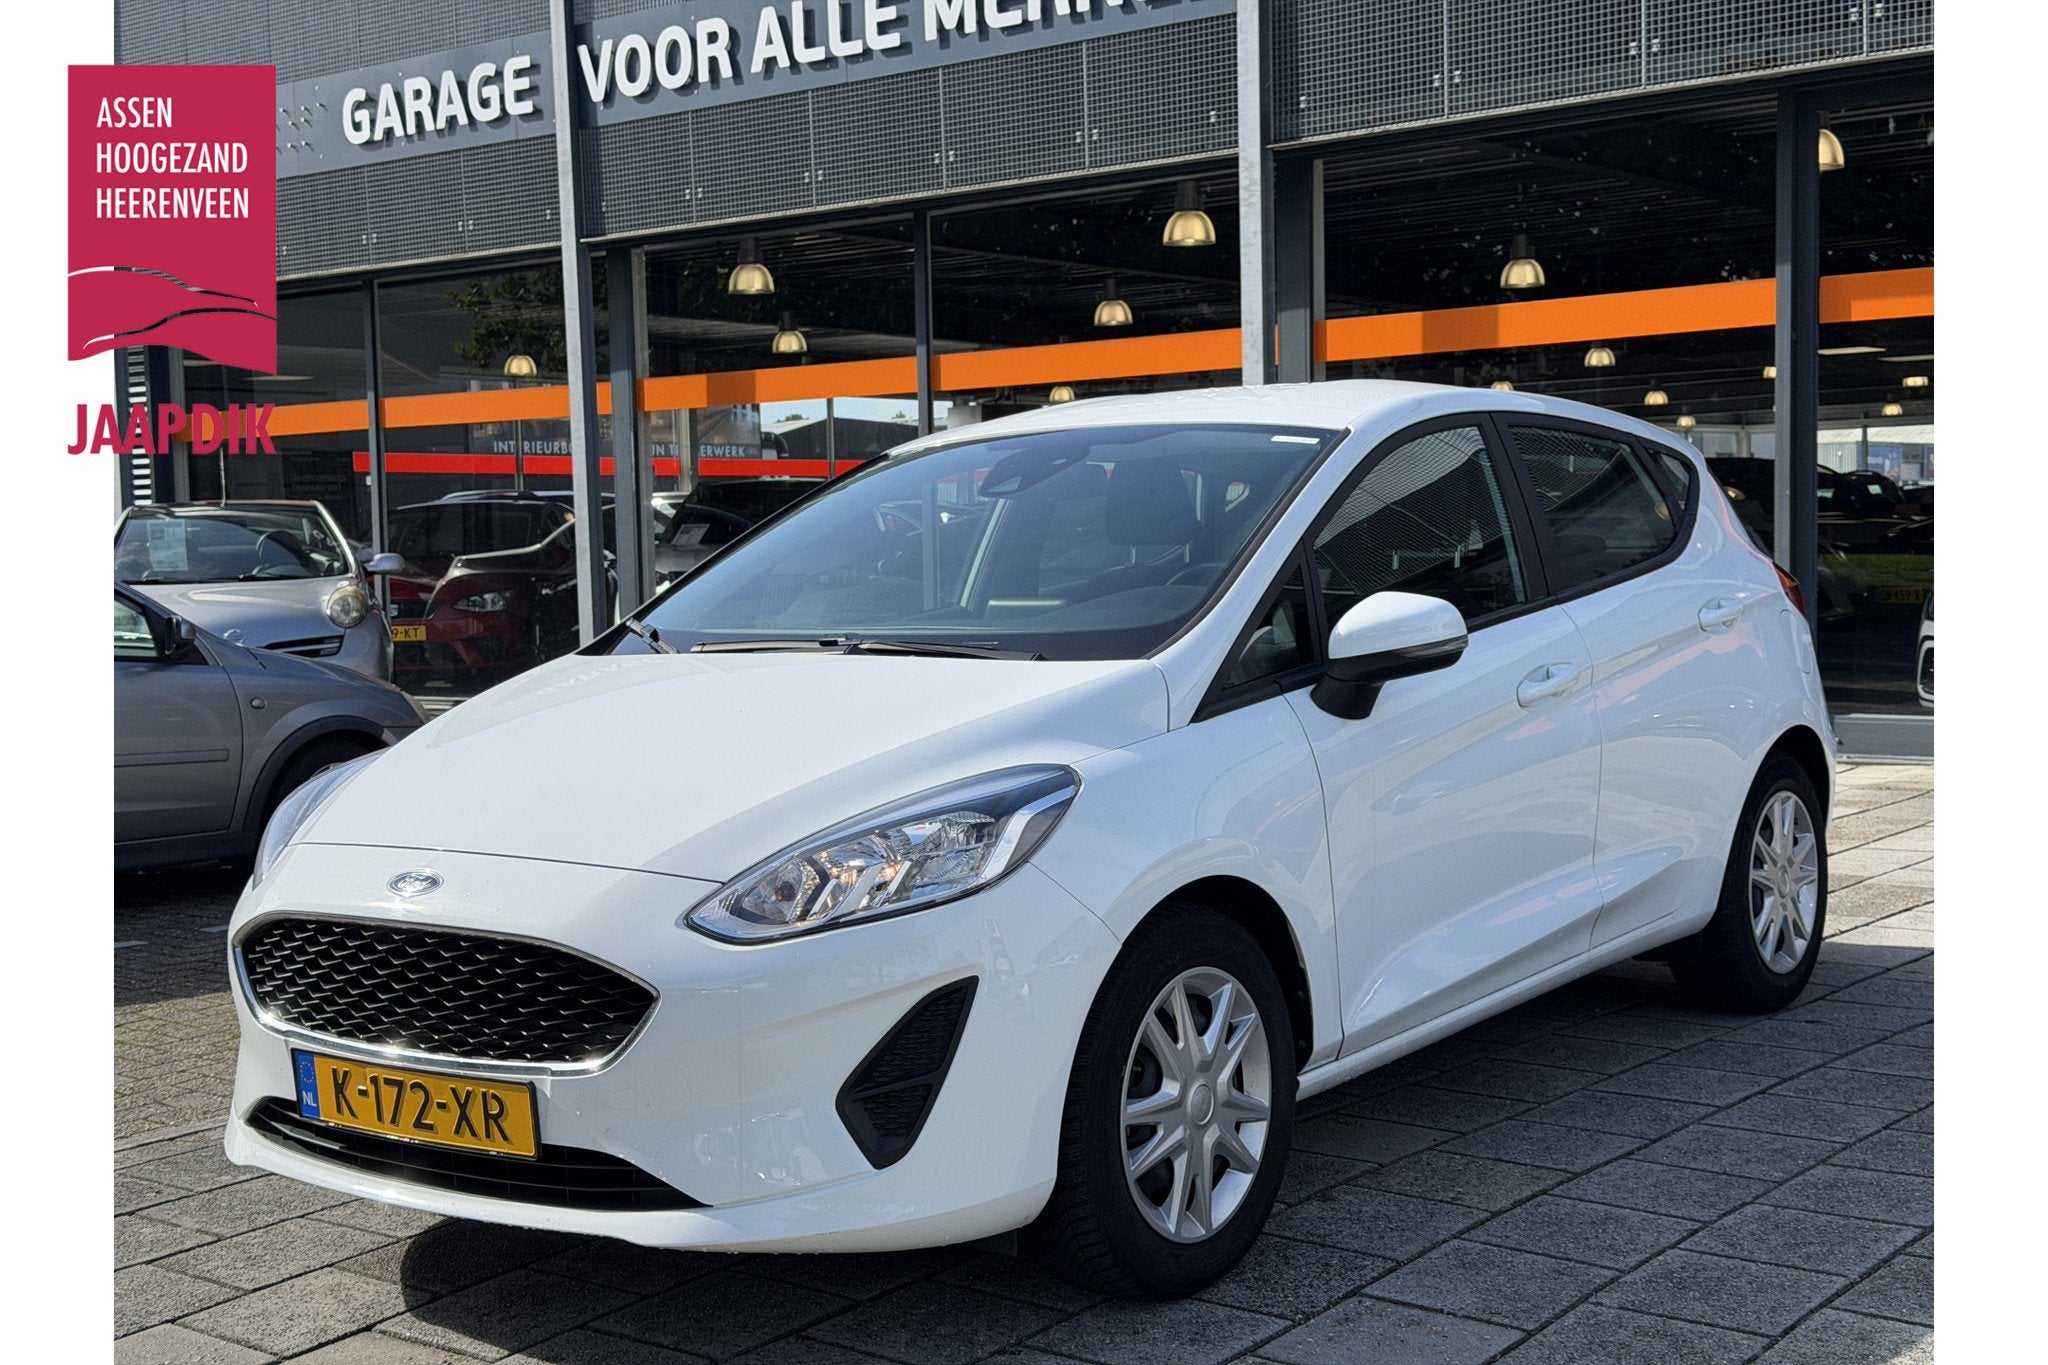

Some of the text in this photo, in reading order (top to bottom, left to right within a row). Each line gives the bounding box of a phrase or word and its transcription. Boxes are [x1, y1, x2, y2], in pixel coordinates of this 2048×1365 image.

[342, 54, 534, 145] GARAGE
[578, 17, 733, 103] VOOR
[749, 0, 902, 74] ALLE
[493, 440, 574, 454] INTRIEURB
[669, 443, 746, 457] TIERWERK
[302, 1090, 317, 1108] NL
[331, 1066, 510, 1143] K-172-XR
